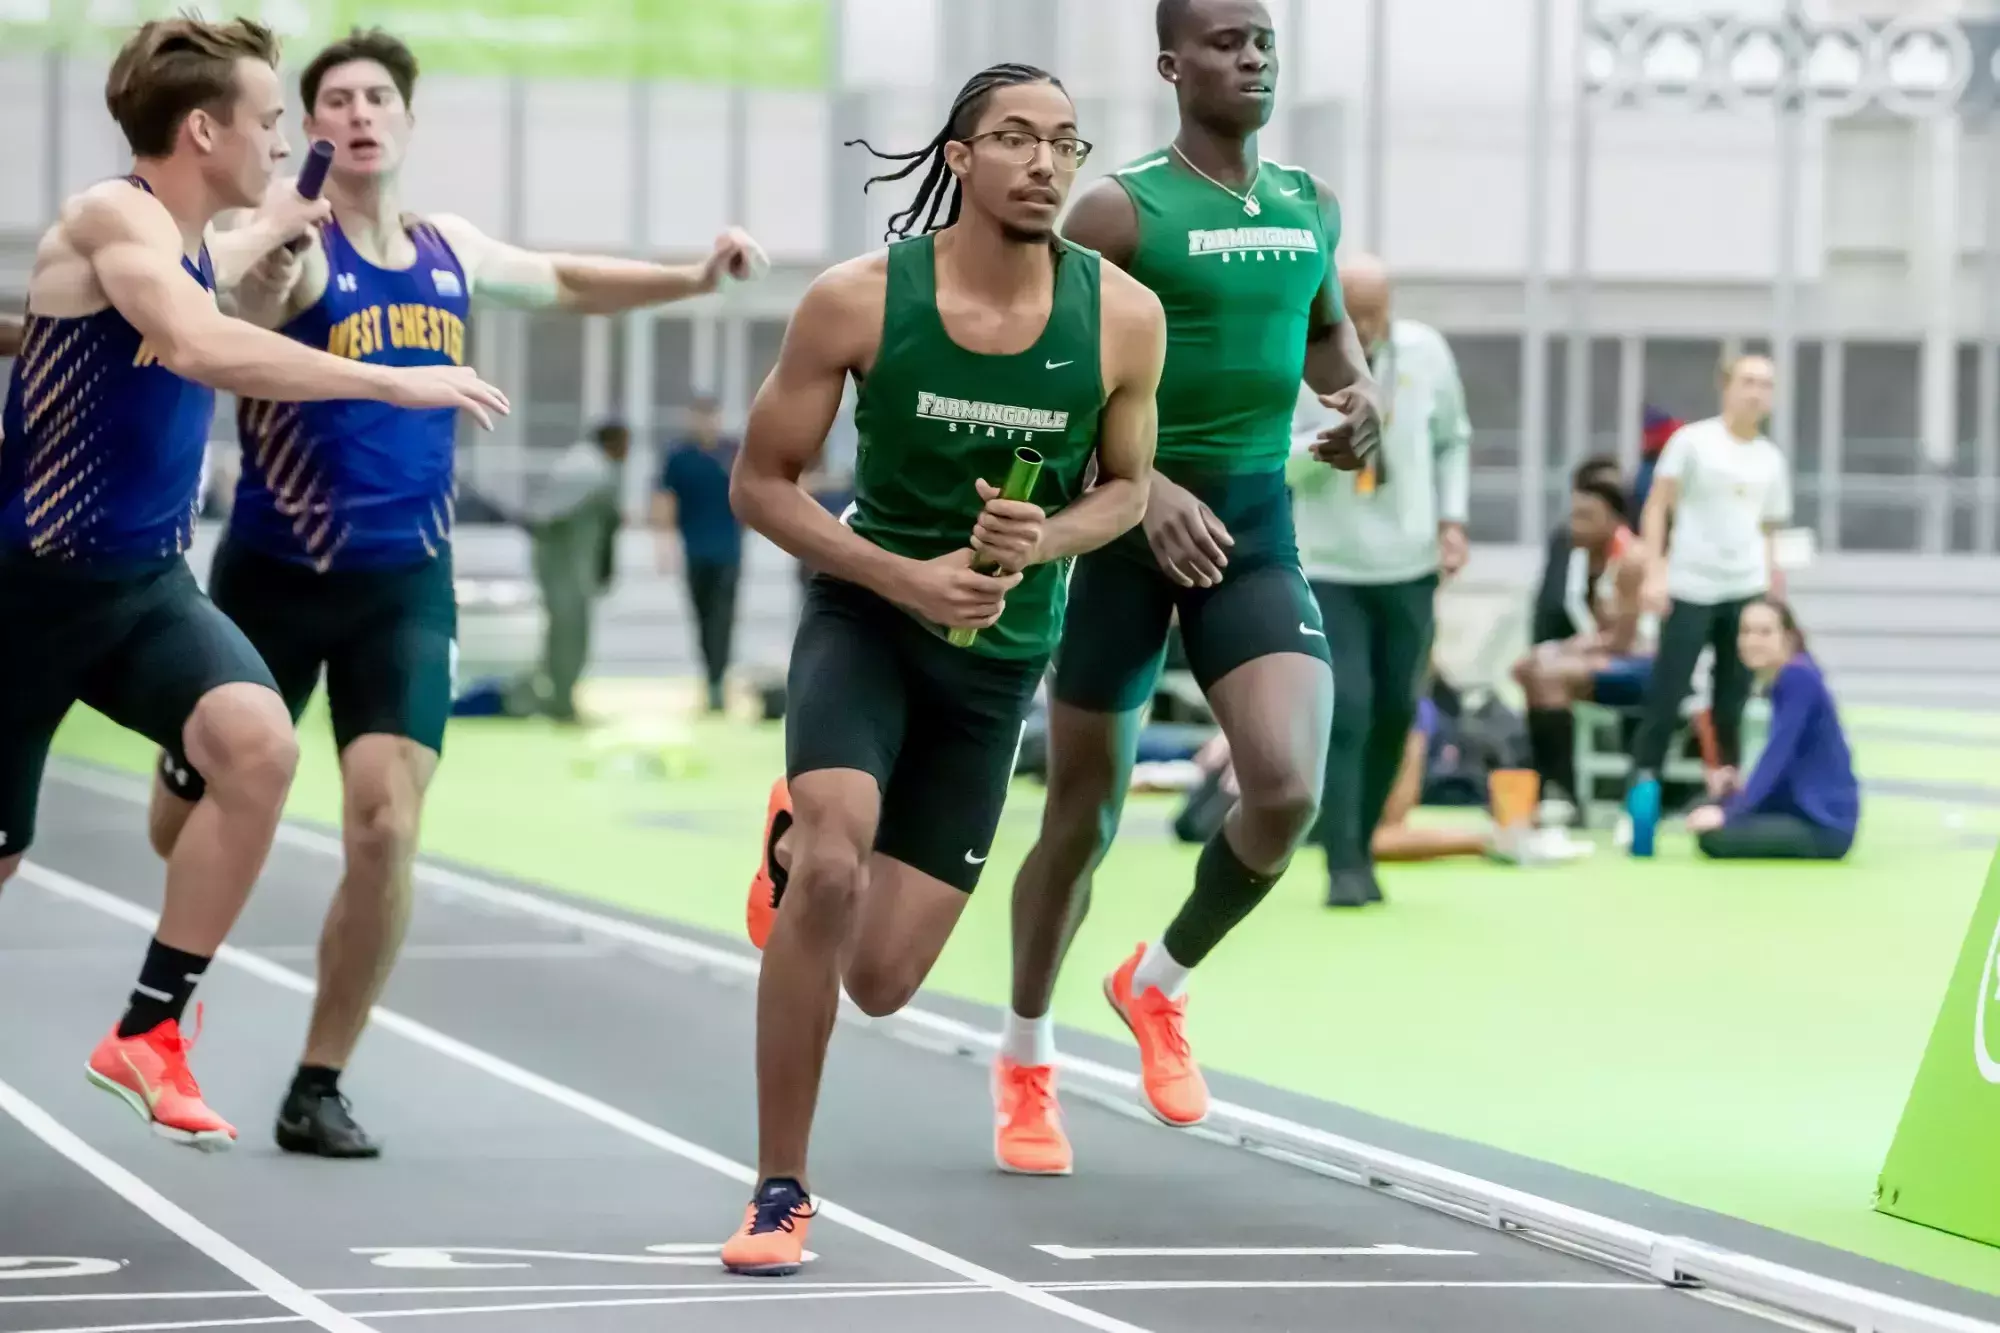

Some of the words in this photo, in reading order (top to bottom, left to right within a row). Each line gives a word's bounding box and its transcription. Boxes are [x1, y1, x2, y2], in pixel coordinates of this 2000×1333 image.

[1187, 227, 1317, 252] FARMINGDALE
[1221, 251, 1297, 263] STATE
[327, 305, 383, 360] WEST
[388, 303, 465, 366] CHESTE
[917, 391, 1069, 428] FARMINGDALE
[949, 422, 1033, 442] STATE
